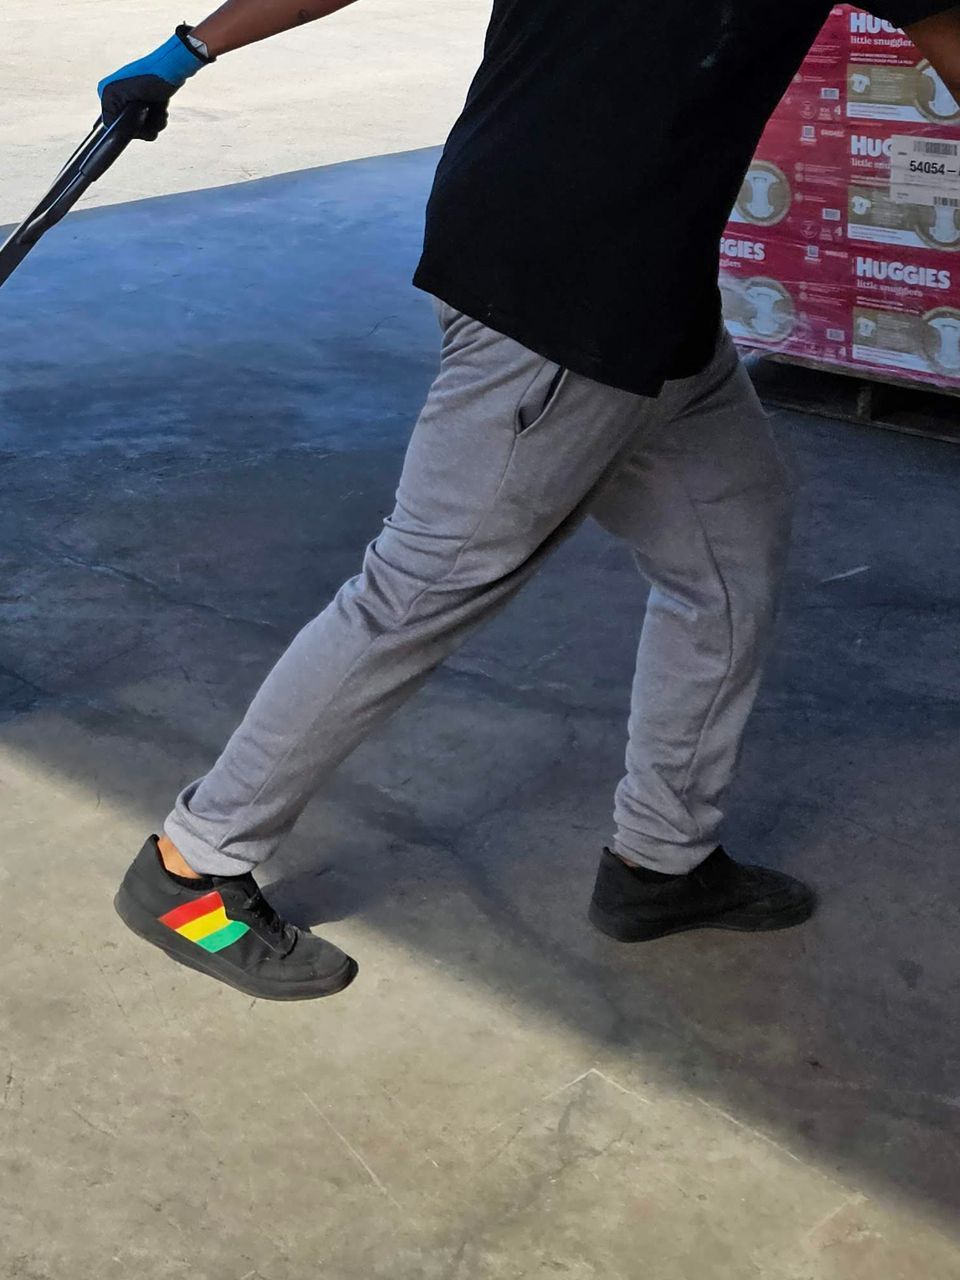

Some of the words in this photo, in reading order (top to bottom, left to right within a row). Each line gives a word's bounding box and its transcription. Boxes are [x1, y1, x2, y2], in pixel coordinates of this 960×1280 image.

[850, 35, 872, 45] little
[910, 160, 945, 175] 54054
[720, 238, 766, 260] GIES
[856, 256, 951, 289] HUGGIES
